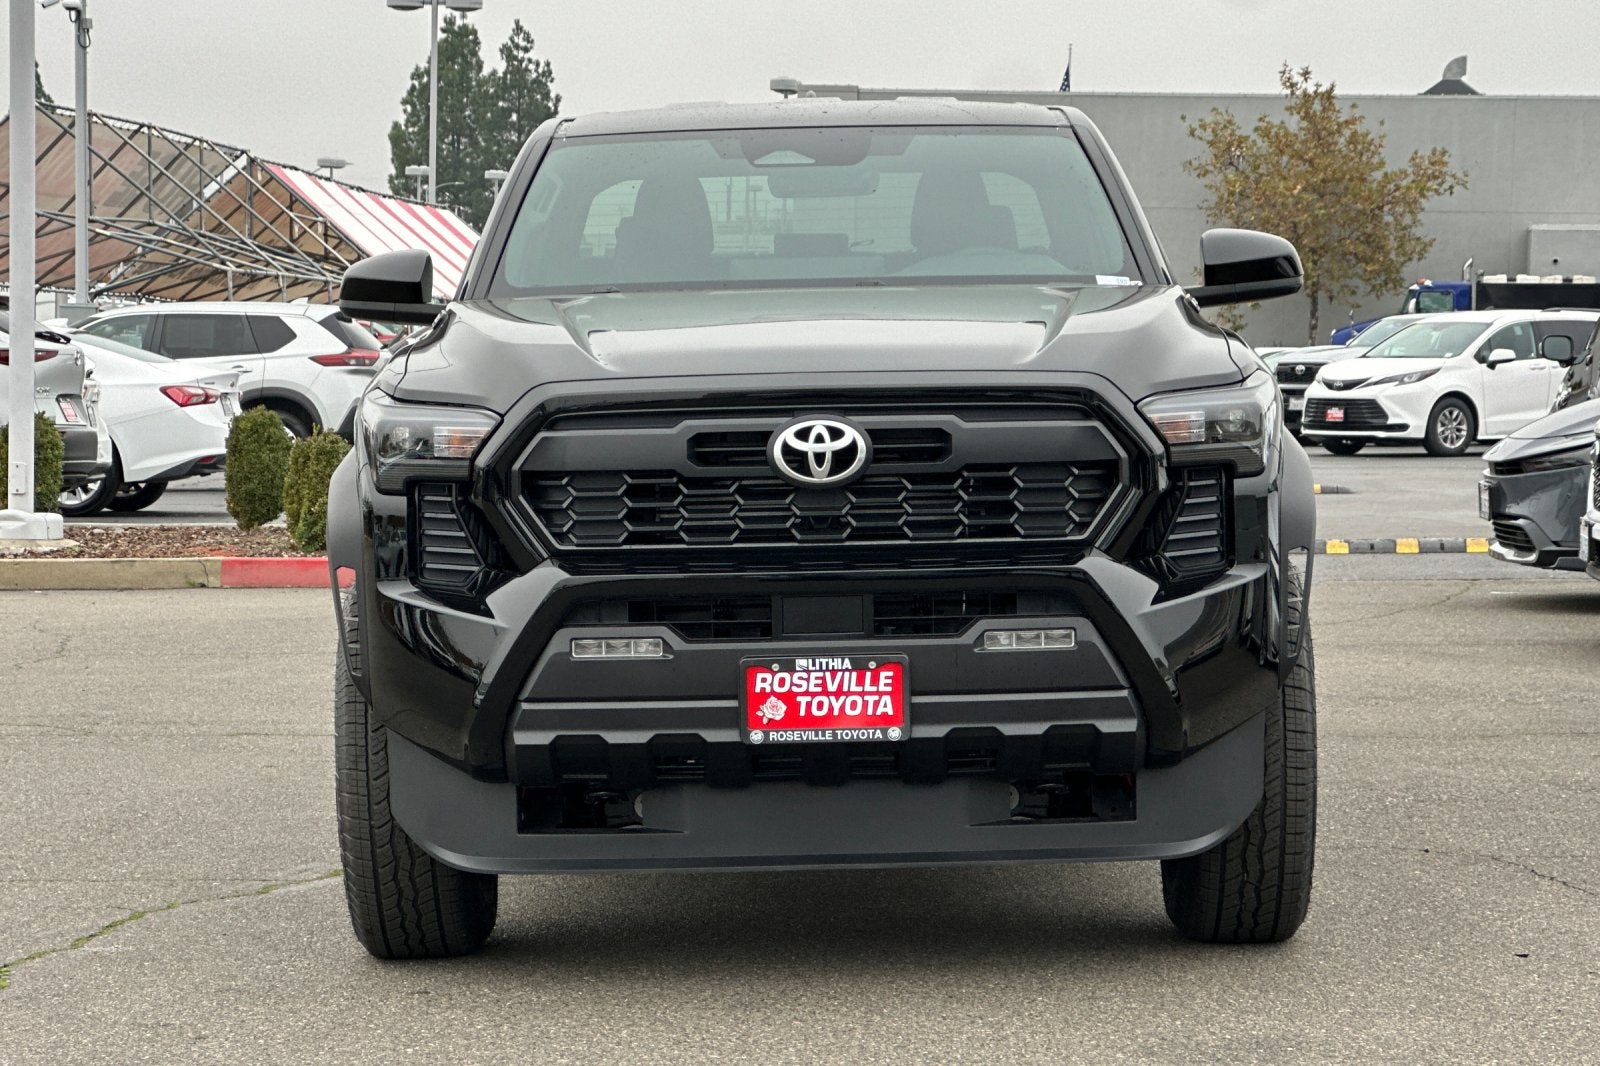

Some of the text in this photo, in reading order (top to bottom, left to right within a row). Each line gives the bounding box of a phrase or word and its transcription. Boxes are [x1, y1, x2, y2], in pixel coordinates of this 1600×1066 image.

[808, 658, 852, 670] LITHIA
[755, 672, 894, 693] ROSEVILLE
[796, 695, 894, 716] TOYOTA
[769, 729, 883, 741] ROSEVILLE TOYOTA
